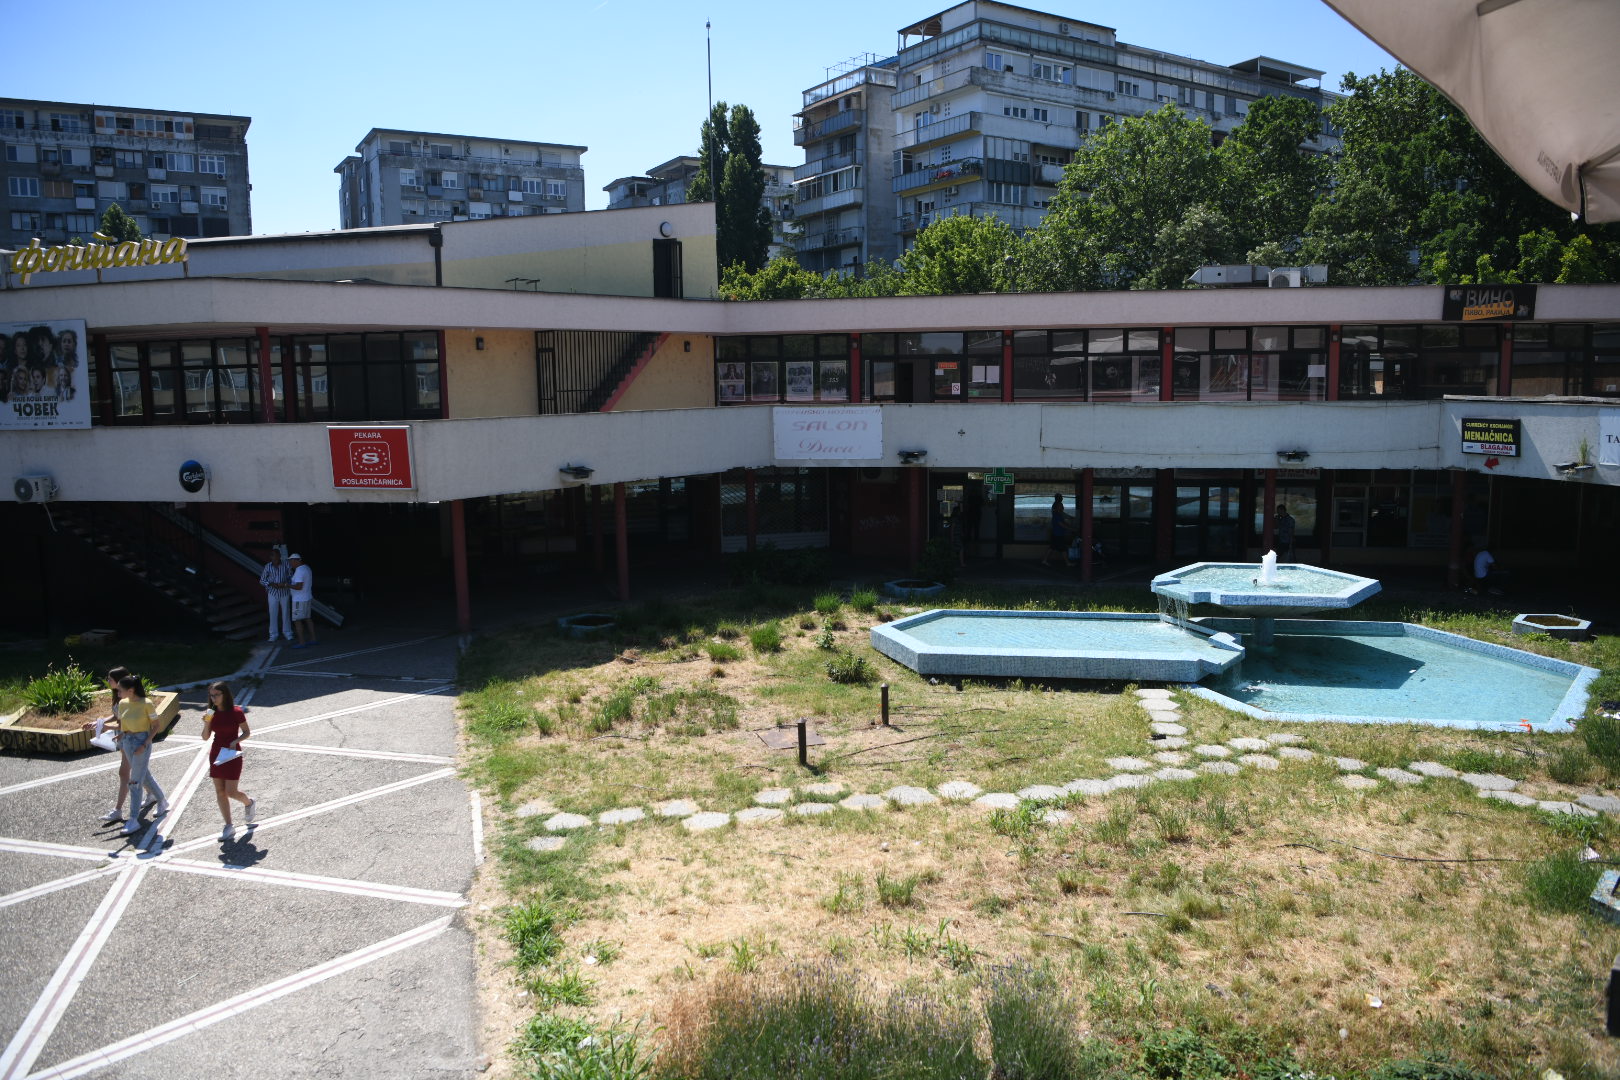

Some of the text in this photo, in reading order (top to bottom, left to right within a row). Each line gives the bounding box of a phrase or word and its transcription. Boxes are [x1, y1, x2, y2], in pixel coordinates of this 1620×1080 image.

[1466, 289, 1514, 308] ВИНО
[13, 403, 59, 416] ЧОВЕК
[1464, 430, 1514, 443] MENJAČNICA
[342, 478, 404, 486] POSLASTIČARNICA
